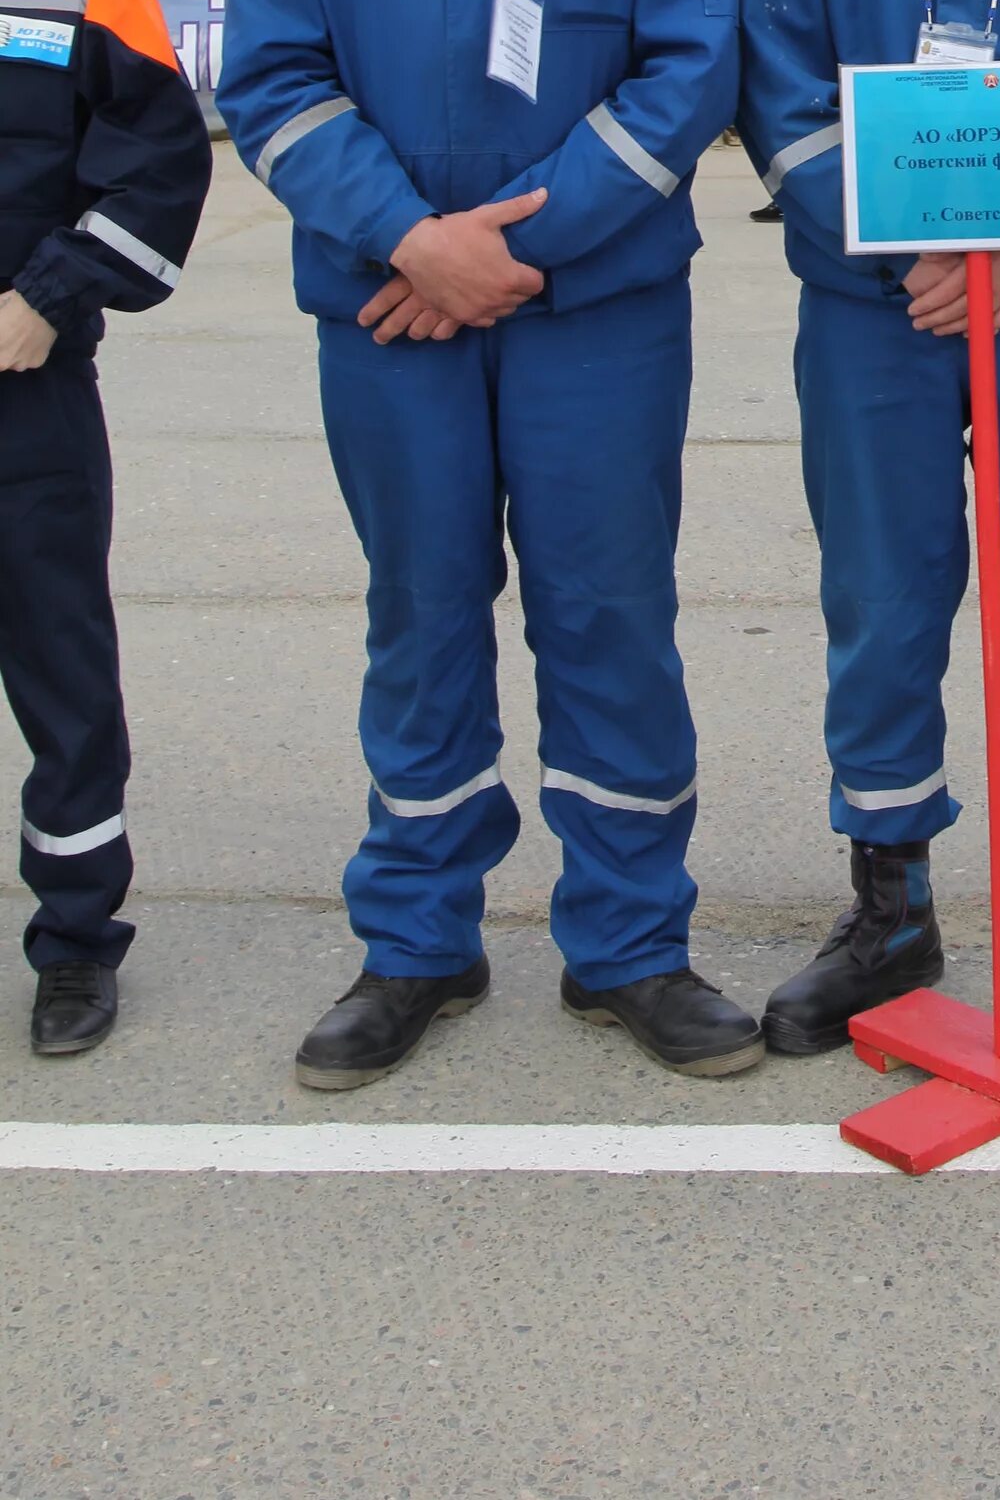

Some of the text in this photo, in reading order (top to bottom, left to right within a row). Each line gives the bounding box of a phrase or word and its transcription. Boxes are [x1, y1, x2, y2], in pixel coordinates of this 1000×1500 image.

[911, 129, 941, 145] АО
[893, 153, 987, 171] Советский
[922, 211, 936, 223] г.
